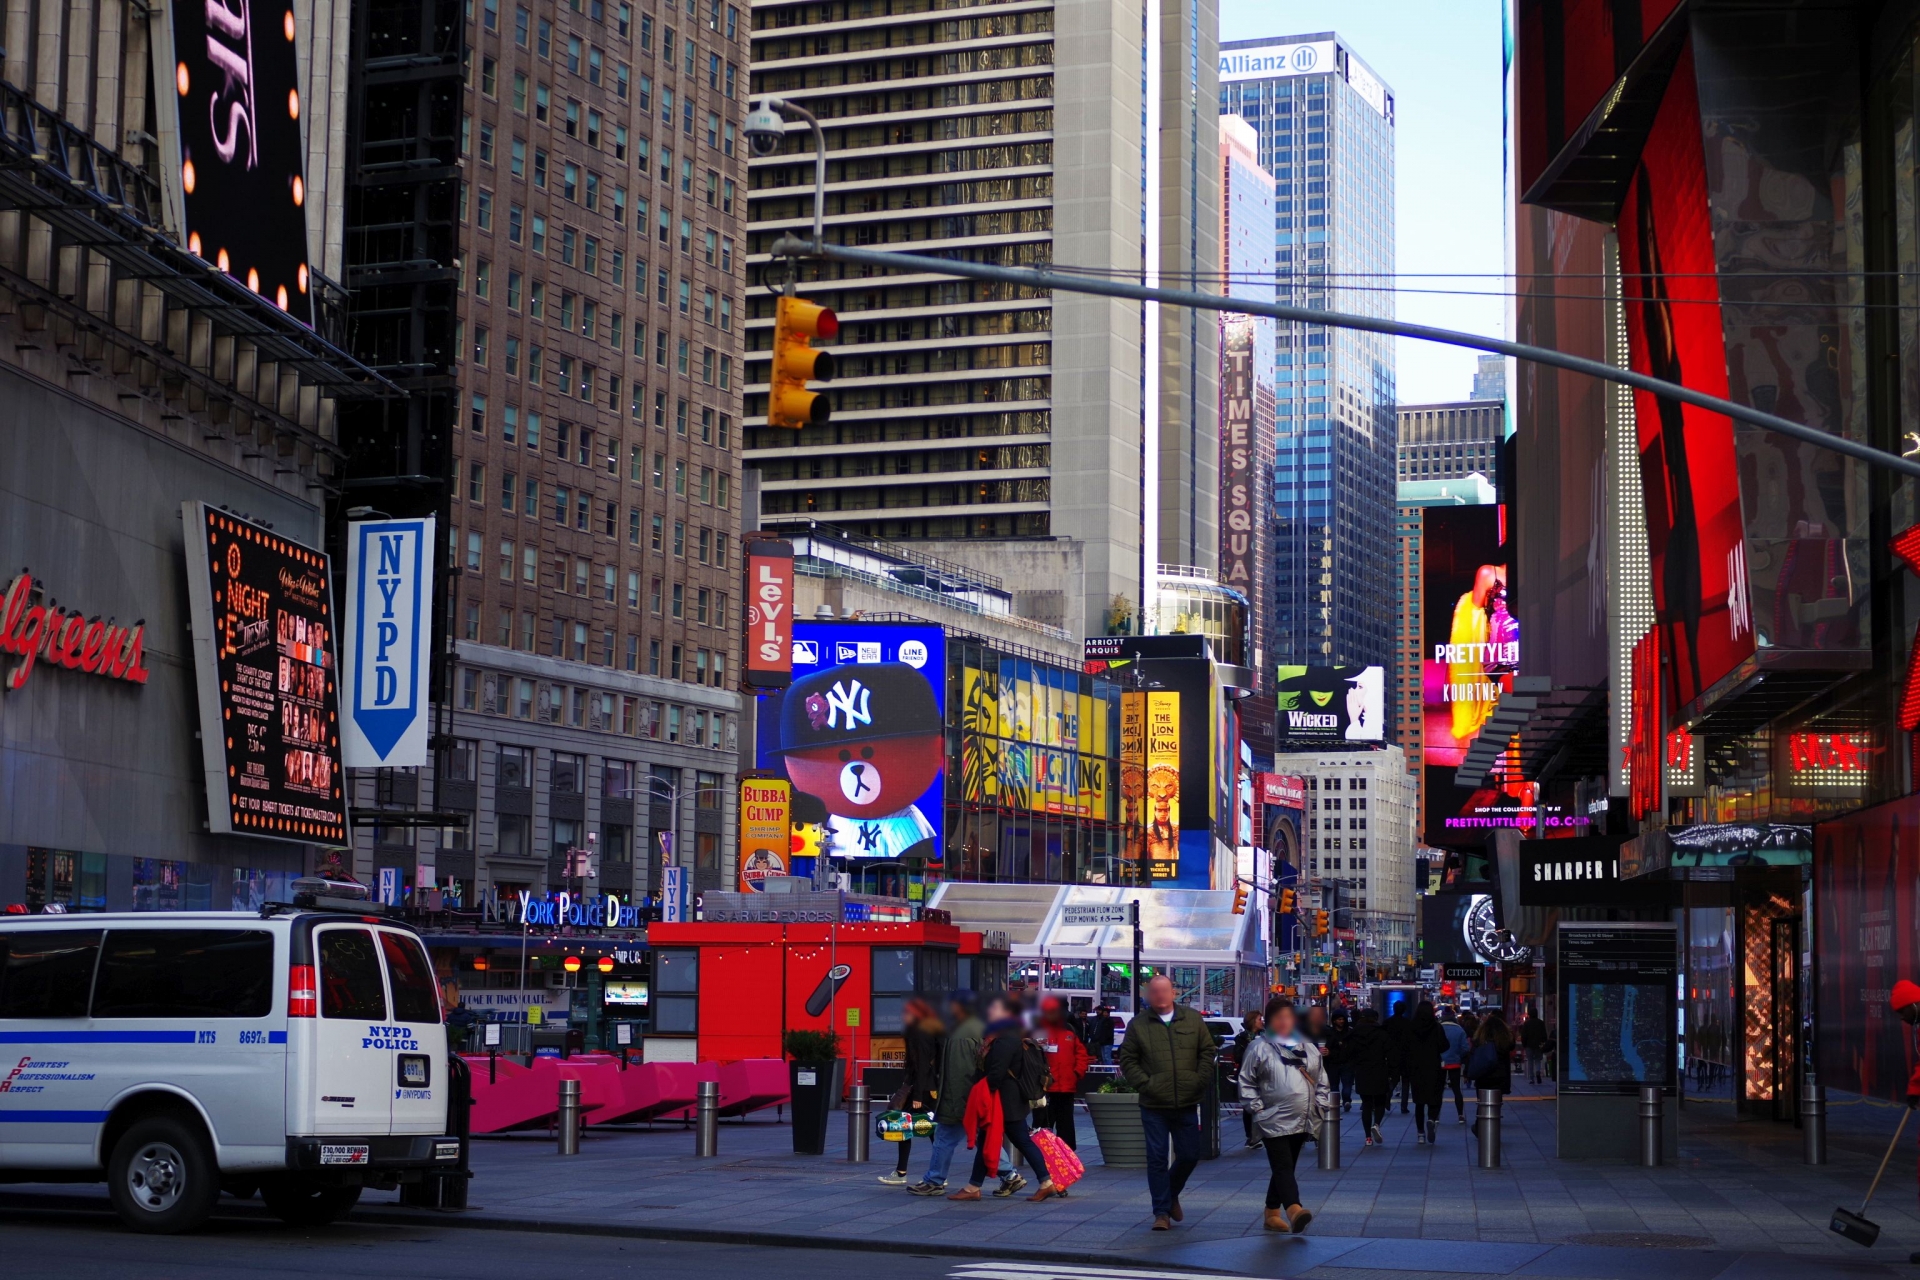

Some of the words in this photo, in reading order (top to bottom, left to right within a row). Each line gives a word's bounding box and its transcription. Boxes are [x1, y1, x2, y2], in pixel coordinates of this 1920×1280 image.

[1219, 54, 1286, 75] Allianz
[1228, 351, 1250, 470] TIMES
[227, 579, 270, 620] NIGHT
[374, 534, 404, 706] NYPD
[1086, 638, 1124, 646] ARRIOTT
[904, 648, 923, 656] LINE
[1154, 714, 1171, 722] THE
[1152, 724, 1174, 736] LION
[1150, 738, 1177, 754] KING
[744, 786, 787, 803] BUBBA
[239, 796, 248, 808] GET
[248, 798, 261, 811] YOUR
[262, 800, 278, 814] BENEFIT
[279, 802, 294, 816] TICKETS
[746, 805, 784, 822] GUMP
[1534, 862, 1602, 882] SHARPER
[518, 890, 554, 924] YORK
[559, 892, 604, 926] POLICE
[607, 895, 641, 928] DEPT
[1064, 906, 1096, 914] PEDESTRIAN
[1097, 906, 1110, 914] FLOW
[1111, 906, 1124, 914] ZONE
[706, 910, 728, 922] U.S.
[732, 910, 779, 922] ARMED
[781, 910, 833, 922] FORCES
[496, 994, 518, 1004] TIMES
[198, 1031, 216, 1044] MTS
[369, 1026, 412, 1038] NYPD
[362, 1038, 418, 1050] POLICE
[18, 1056, 70, 1068] COURTESY
[882, 1052, 892, 1060] HAI
[7, 1068, 96, 1080] PROFESSIONALISM
[0, 1081, 44, 1092] RESPECT
[403, 1090, 432, 1100] @NYPDMTS
[346, 1146, 368, 1154] REWARD
